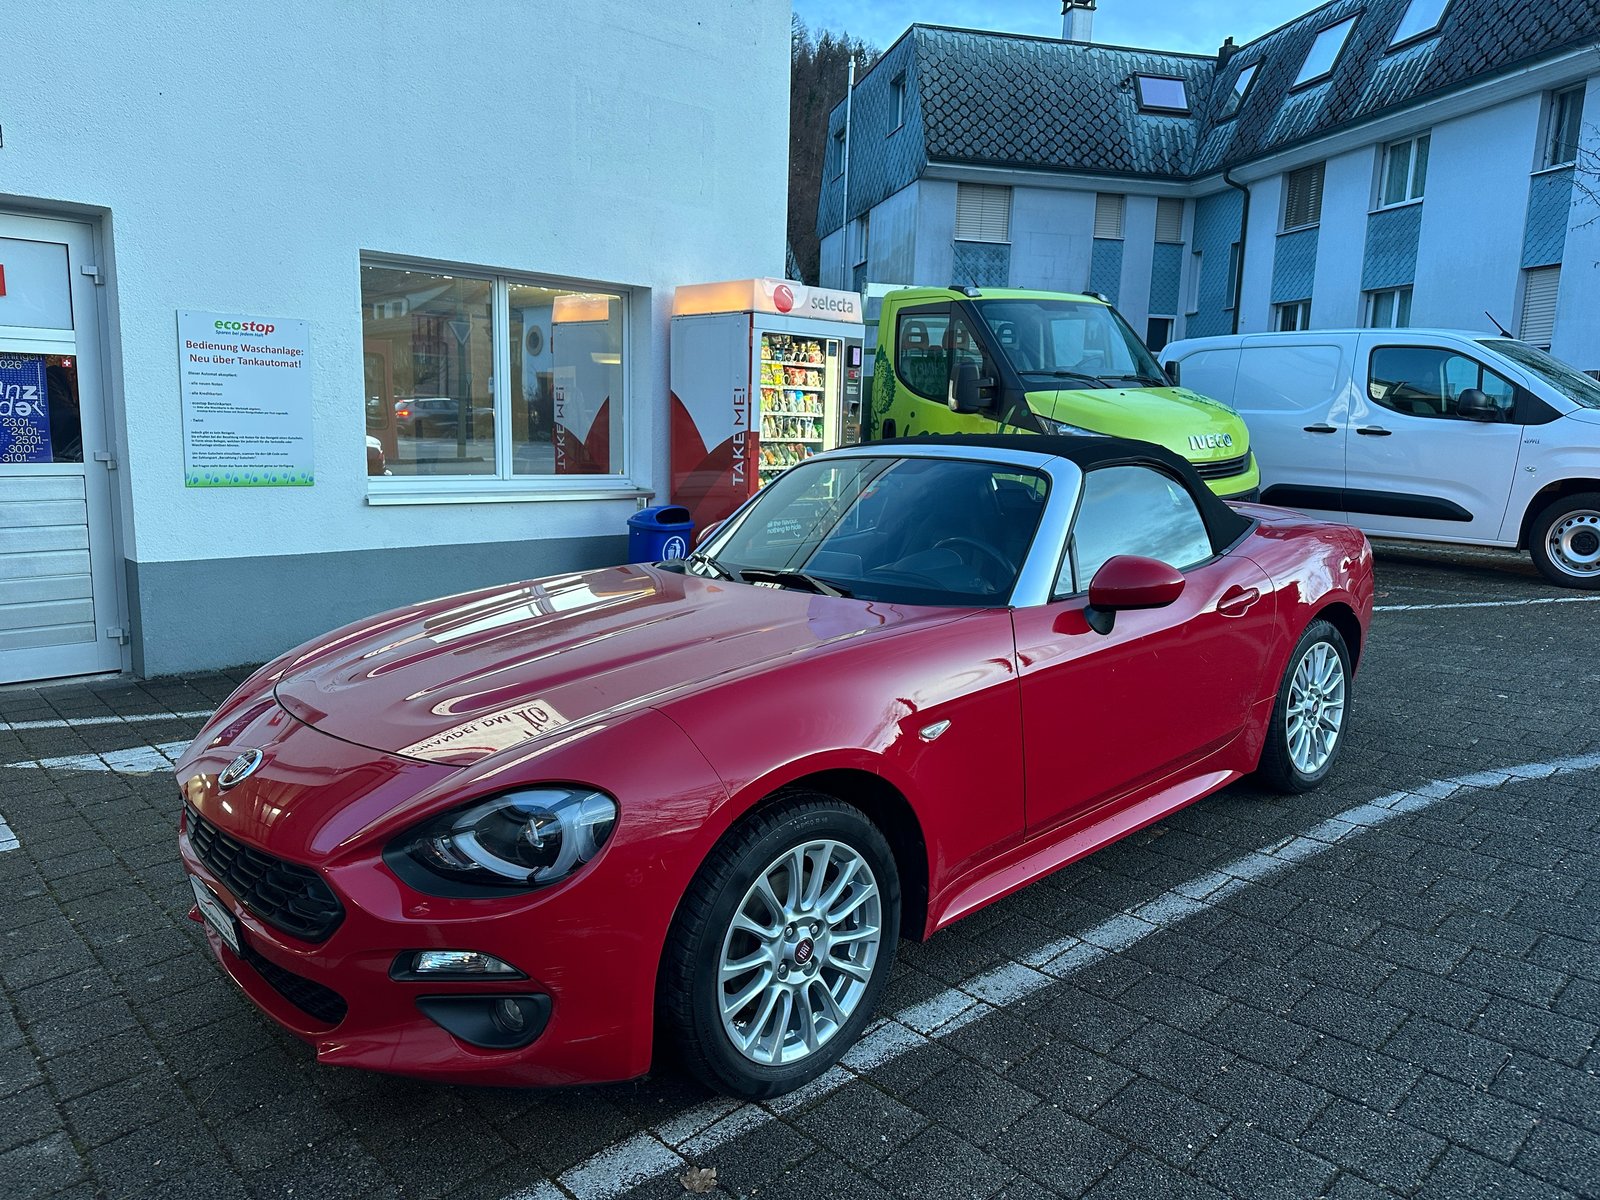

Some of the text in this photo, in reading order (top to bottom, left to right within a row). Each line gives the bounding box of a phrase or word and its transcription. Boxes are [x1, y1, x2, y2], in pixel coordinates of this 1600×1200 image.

[811, 296, 853, 313] selecta
[214, 320, 275, 335] ecostop
[186, 340, 304, 357] Bedienung Waschanlage:
[0, 360, 22, 370] 026
[189, 354, 302, 368] Neu über Tankautomat!
[2, 418, 31, 427] 23.01.
[11, 427, 40, 436] 24.01.
[732, 388, 745, 486] TAKE ME!
[15, 436, 43, 444] 25.01.
[1188, 432, 1232, 450] IVECO
[8, 445, 37, 453] 30.01.
[2, 454, 29, 462] 31.01.
[797, 942, 810, 960] FIAT
